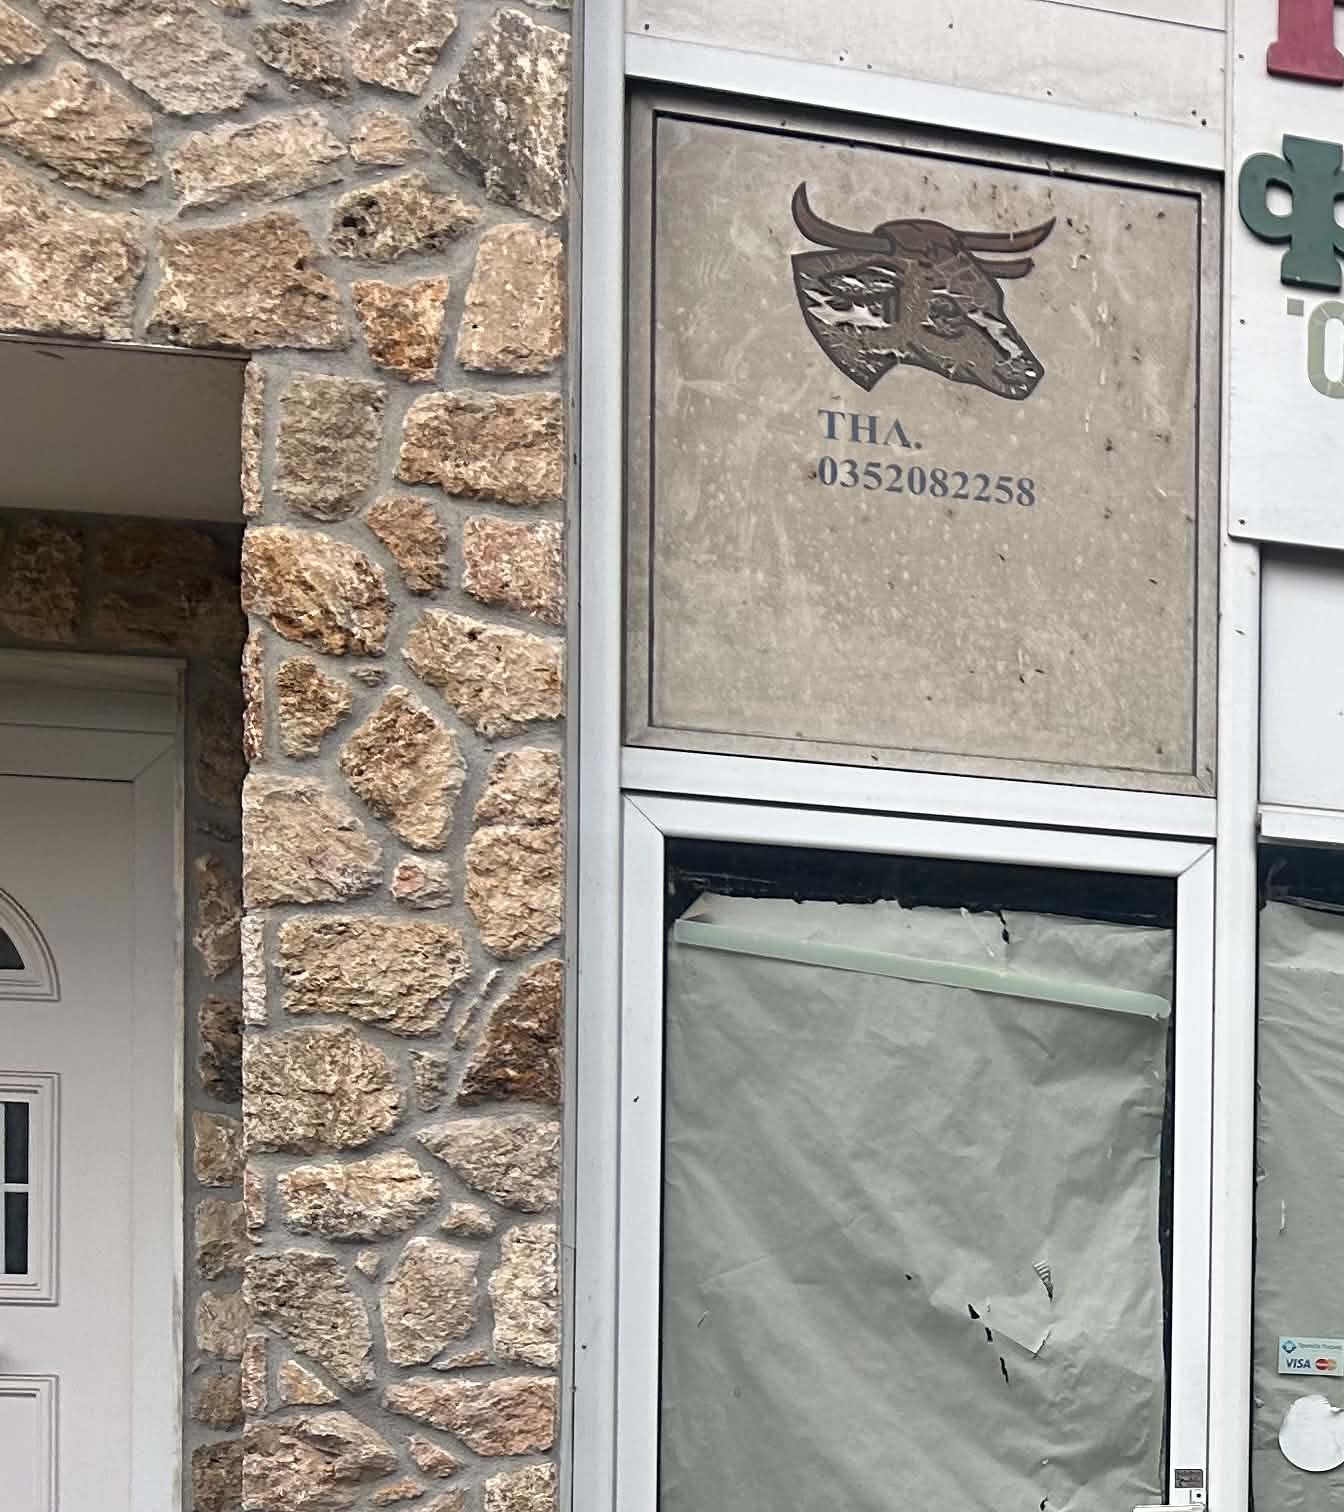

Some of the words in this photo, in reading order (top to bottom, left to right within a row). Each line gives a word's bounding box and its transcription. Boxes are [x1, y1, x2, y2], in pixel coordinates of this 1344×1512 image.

[817, 409, 922, 449] ΤΗΛ.
[817, 456, 1036, 507] 0352082258
[1286, 1358, 1312, 1369] VISA
